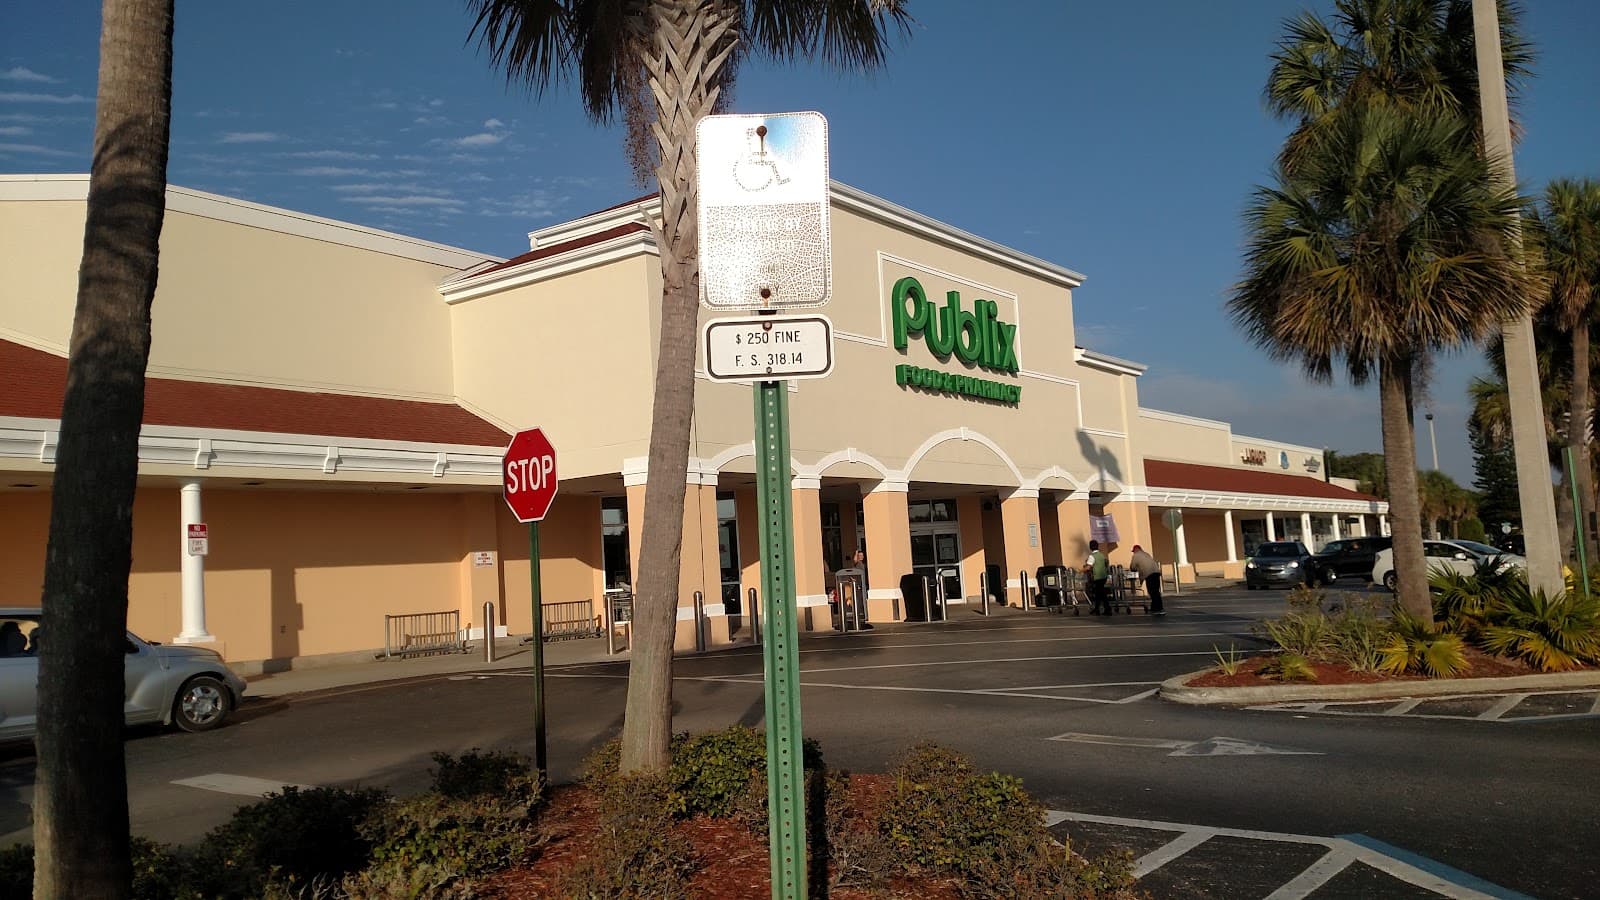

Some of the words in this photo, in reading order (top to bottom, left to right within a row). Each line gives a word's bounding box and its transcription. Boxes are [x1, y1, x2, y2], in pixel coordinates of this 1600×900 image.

[736, 333, 742, 344] $
[747, 332, 769, 344] 250
[775, 331, 801, 343] FINE
[892, 277, 1019, 372] Publix
[735, 355, 744, 367] F.
[751, 354, 761, 366] S.
[767, 352, 803, 366] 318.14
[896, 364, 941, 389] FOOD
[952, 375, 1021, 402] PHARMACY
[507, 455, 553, 494] STOP
